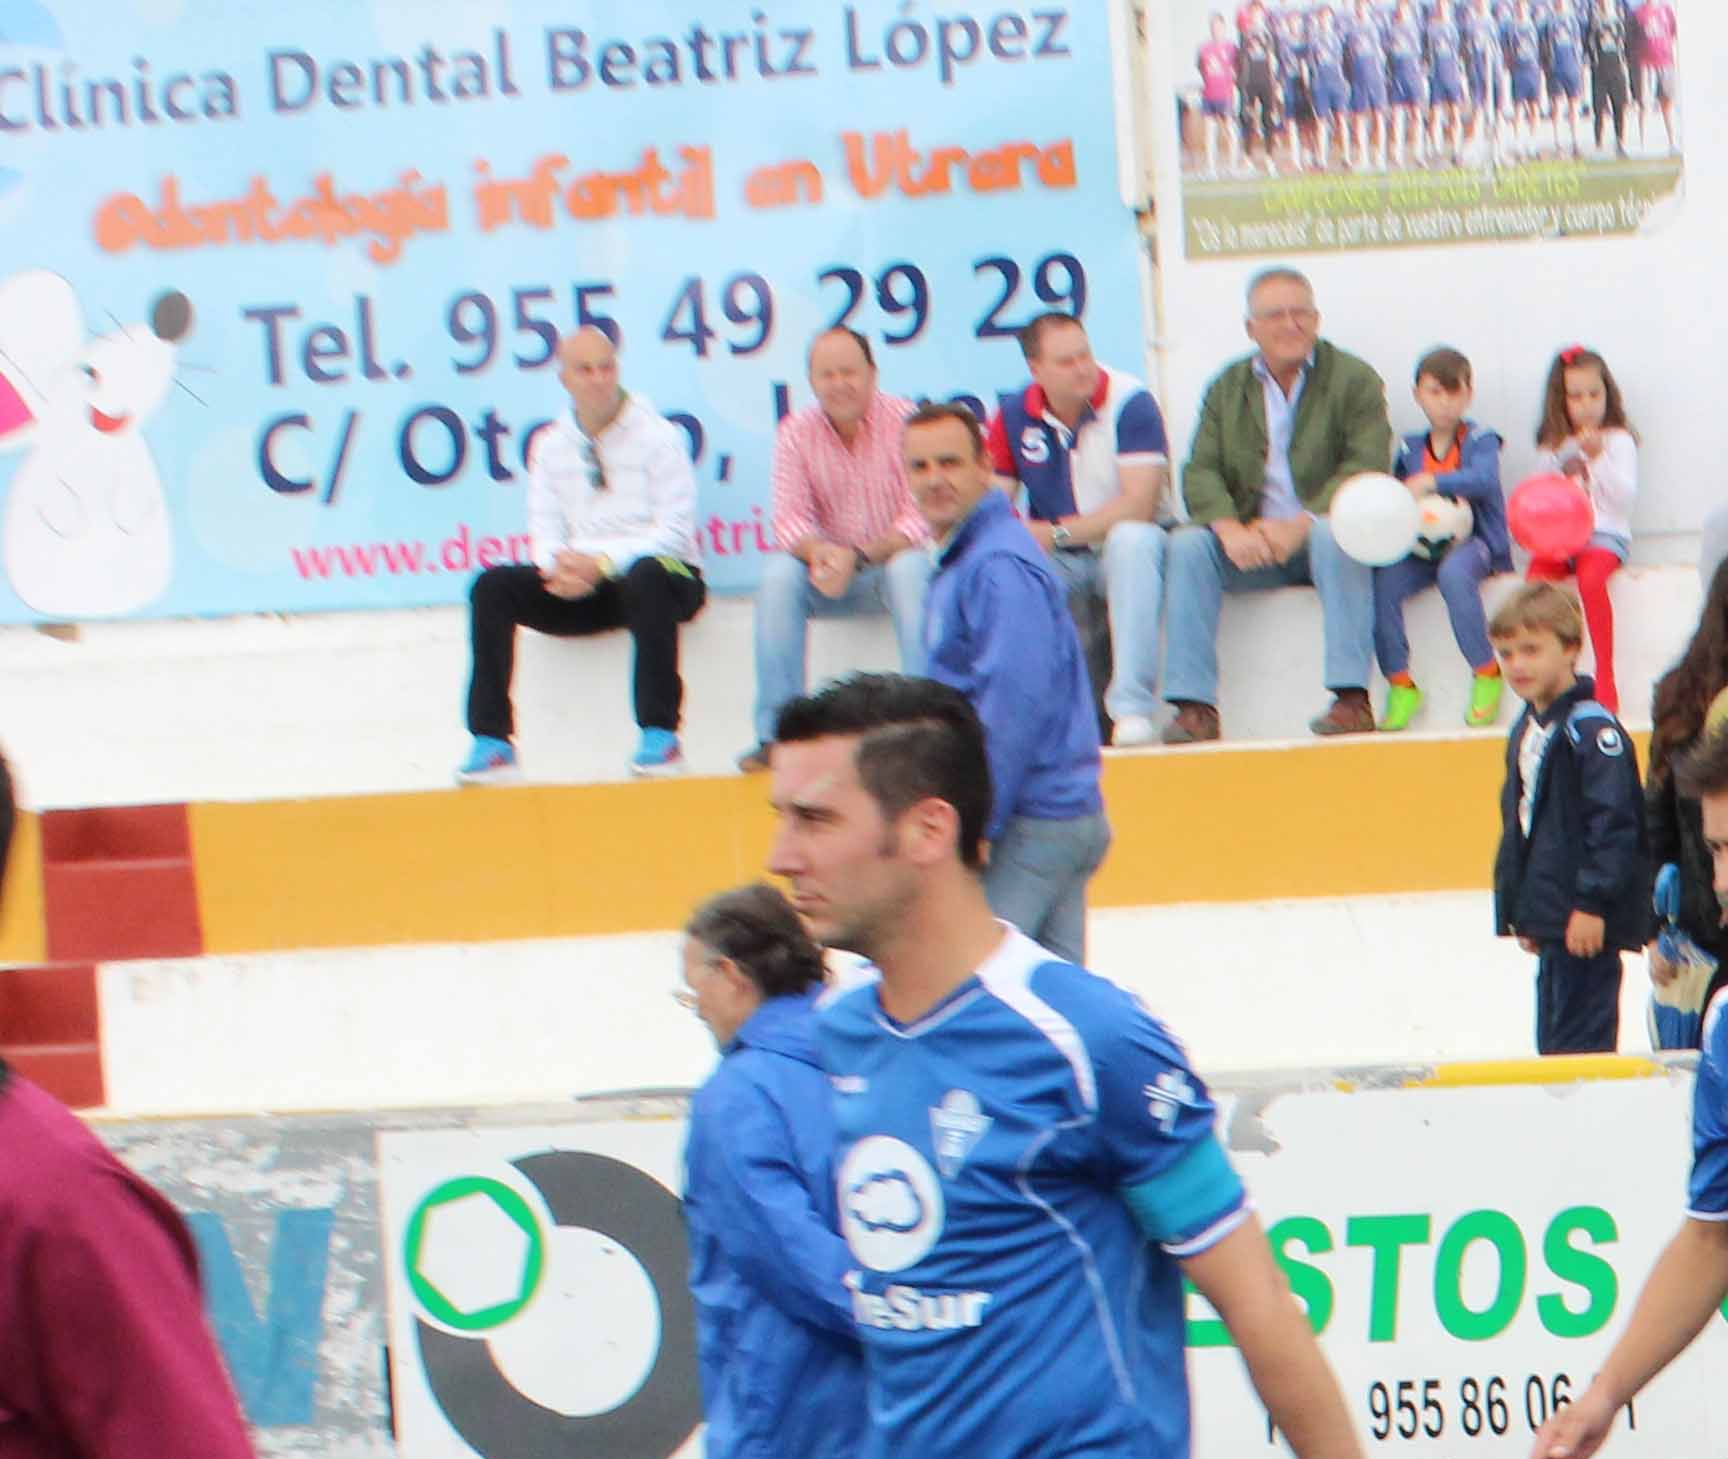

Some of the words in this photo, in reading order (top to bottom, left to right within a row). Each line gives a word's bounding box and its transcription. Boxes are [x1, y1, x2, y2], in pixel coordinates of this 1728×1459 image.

[0, 55, 241, 131] Clínica
[265, 28, 520, 114] Dental
[543, 9, 818, 92] Beatriz
[843, 0, 1071, 87] López
[471, 145, 717, 232] infantil
[241, 293, 414, 387] Tel.
[446, 278, 624, 376] 955
[660, 271, 776, 358] 49
[817, 262, 932, 346] 29
[971, 251, 1088, 339] 29
[256, 408, 361, 508] C/
[1369, 1378, 1444, 1442] 955
[1459, 1375, 1509, 1437] 86
